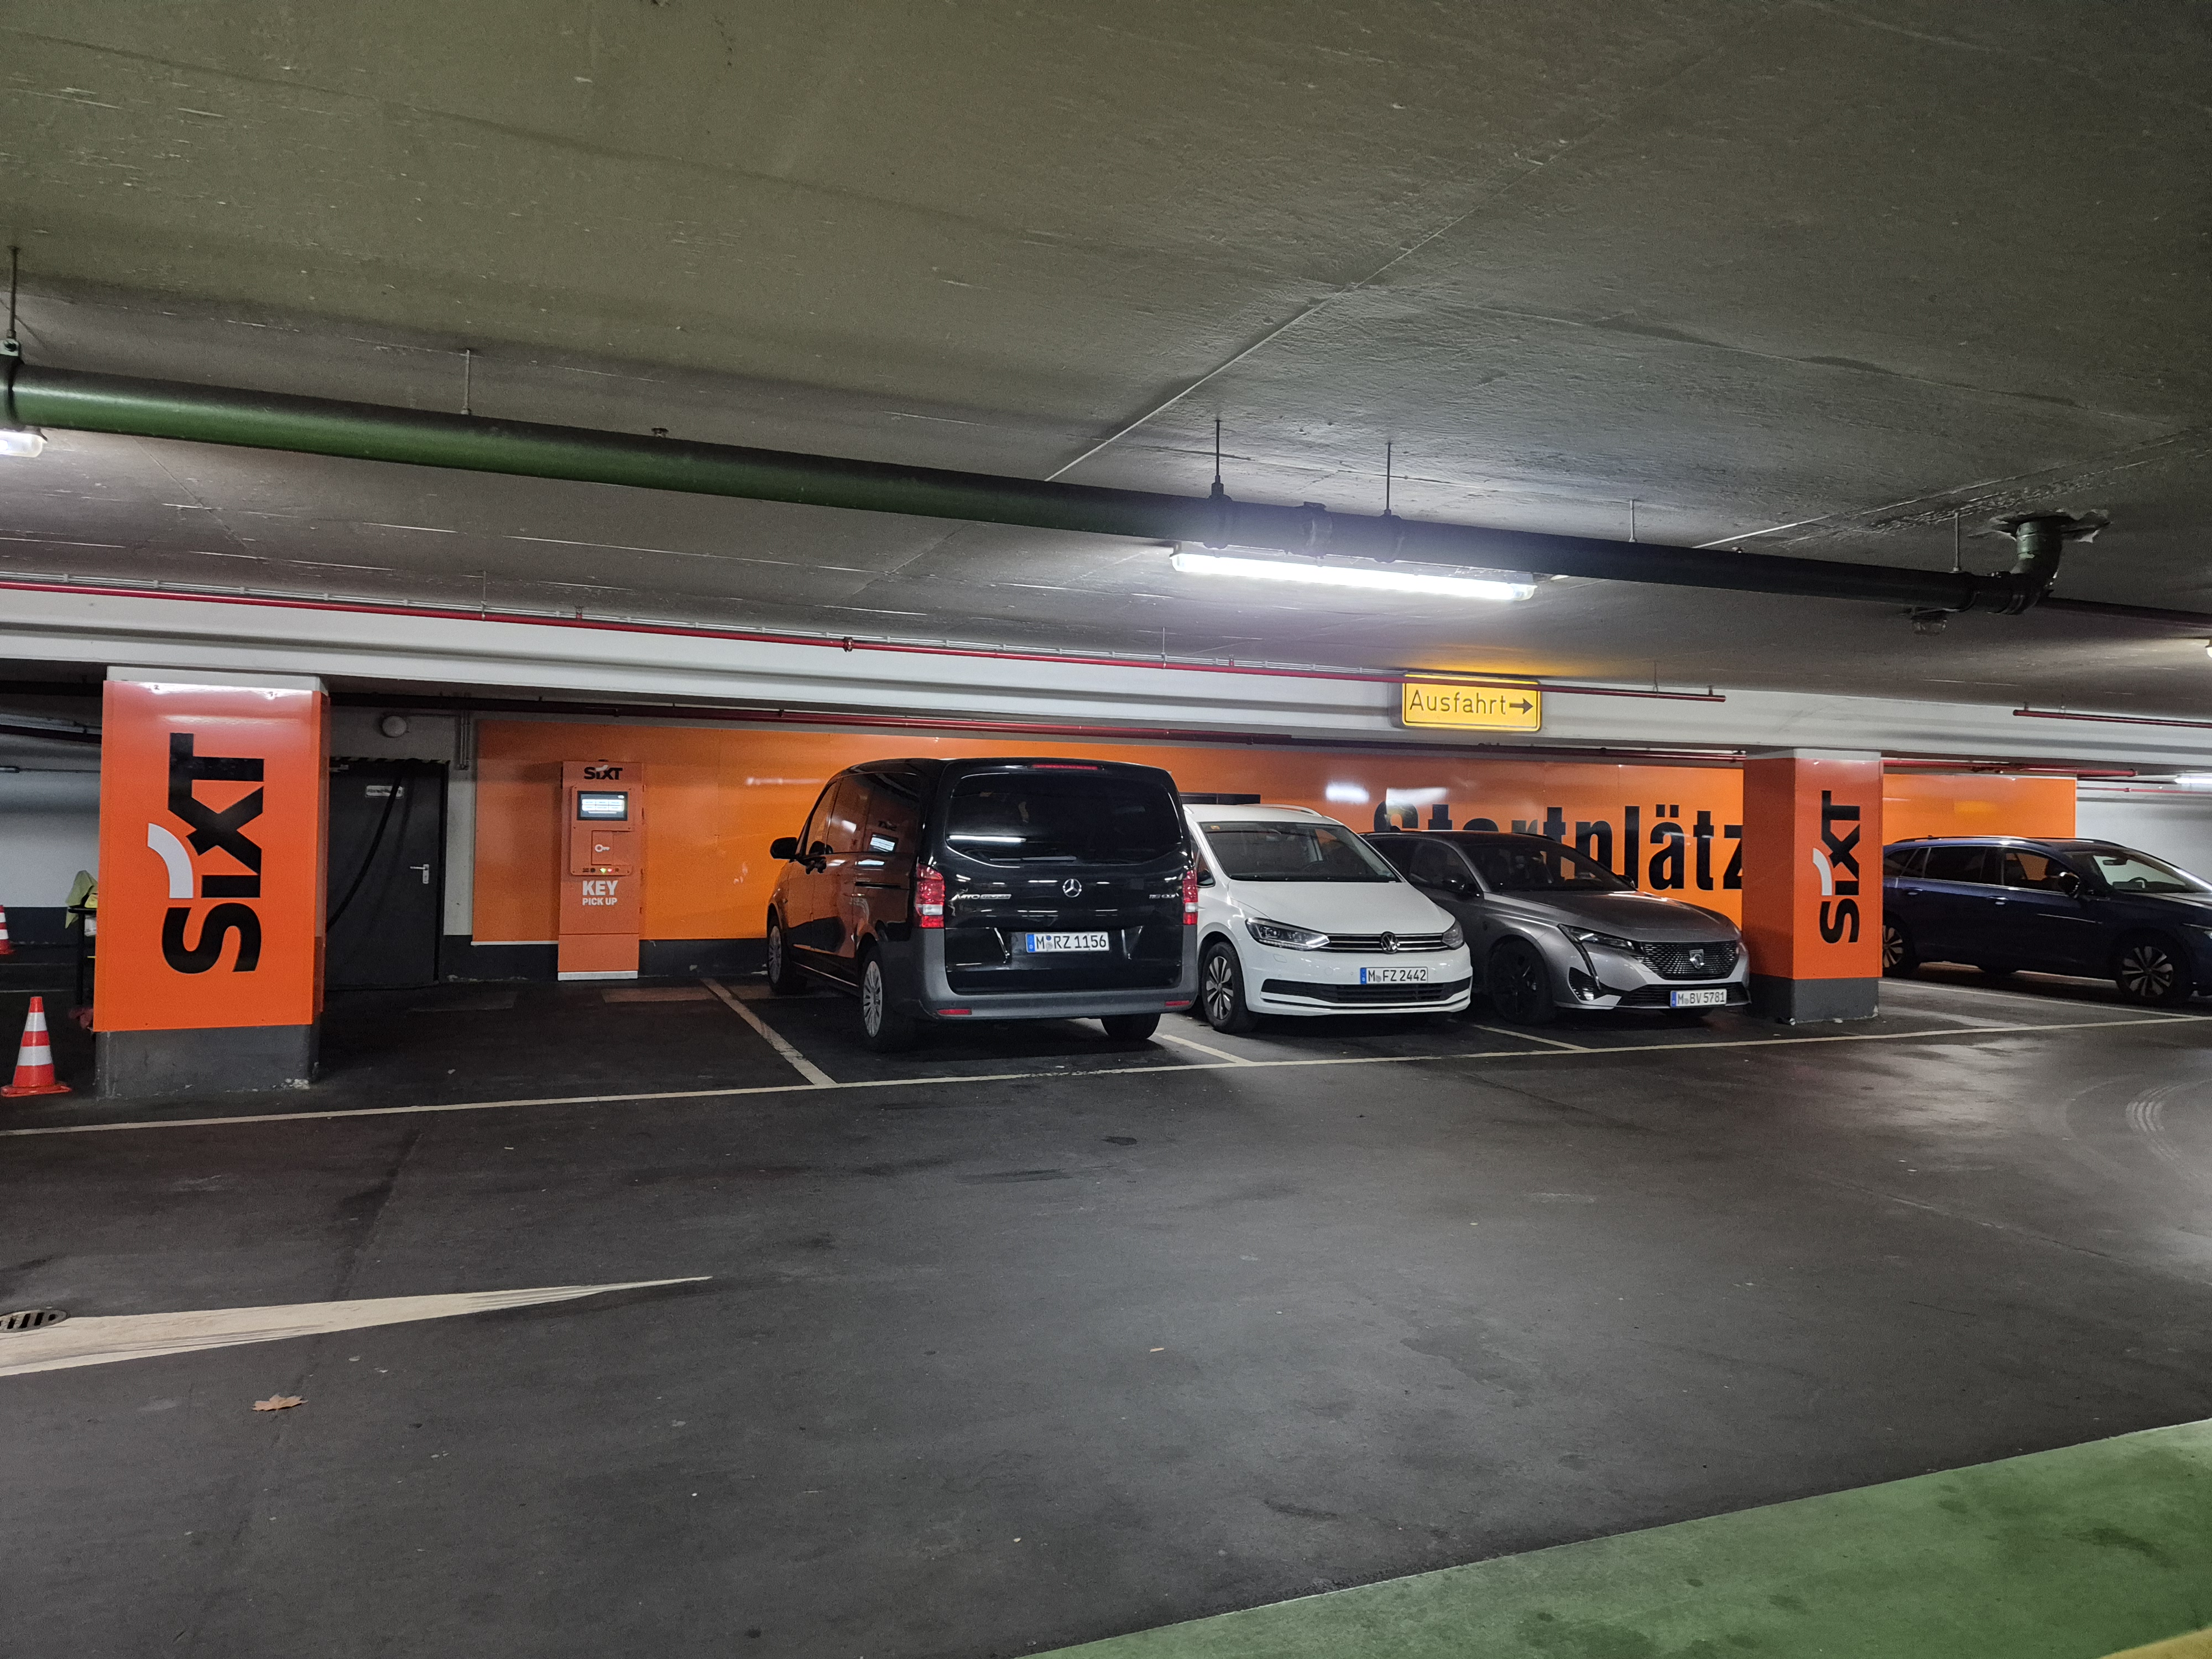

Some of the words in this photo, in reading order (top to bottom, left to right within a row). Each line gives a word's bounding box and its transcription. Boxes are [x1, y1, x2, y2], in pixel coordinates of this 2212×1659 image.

[1410, 689, 1506, 715] Ausfahrt
[584, 765, 623, 780] SIXT
[148, 732, 264, 974] SIXT
[1813, 790, 1860, 943] SIXT
[582, 880, 618, 896] KEY
[582, 897, 604, 906] PICK
[605, 897, 618, 906] UP
